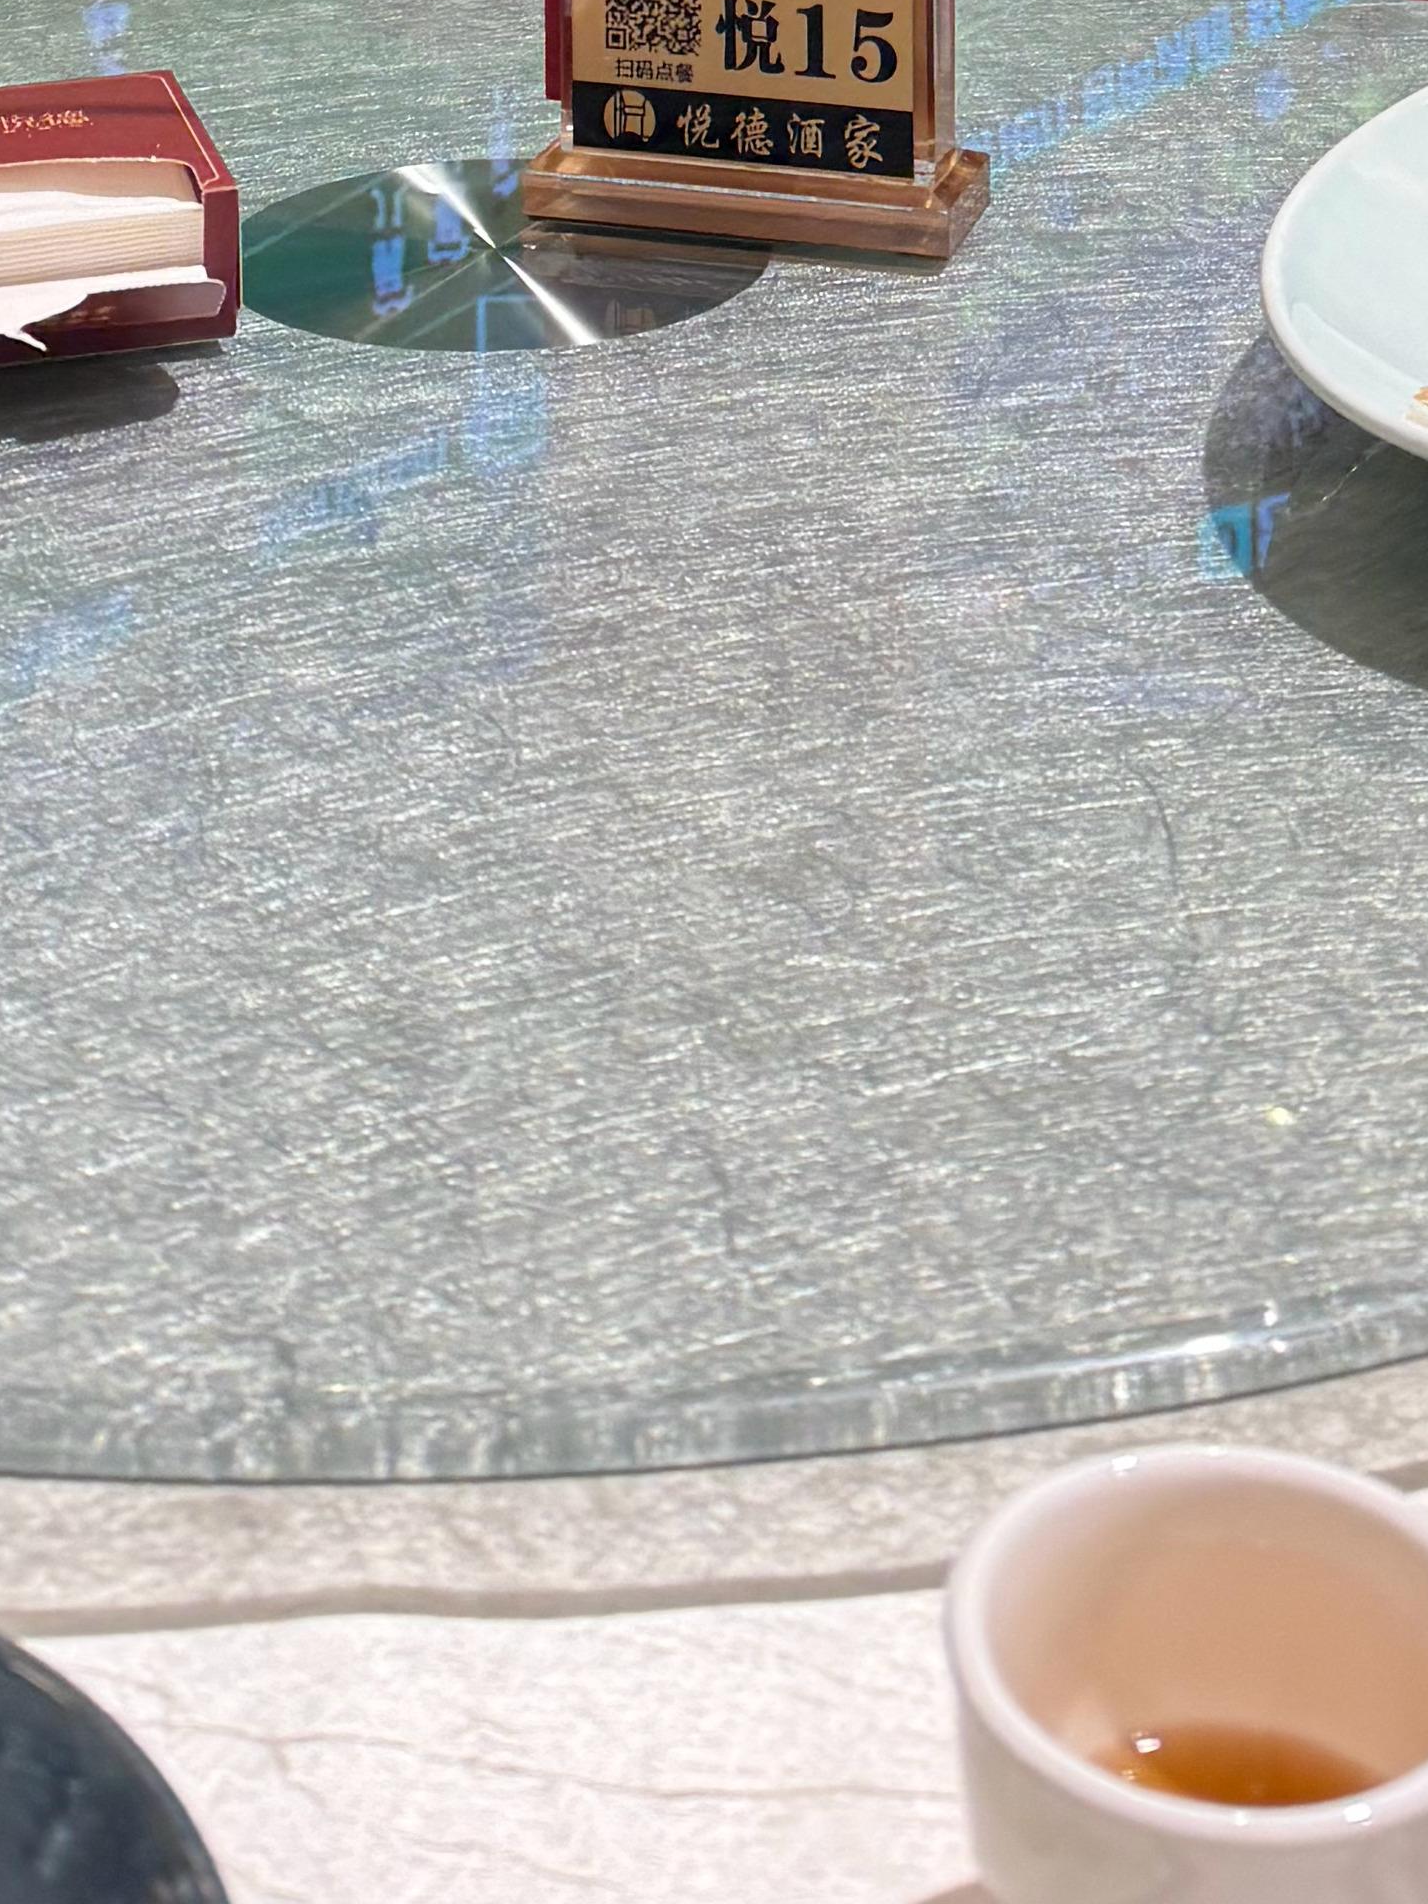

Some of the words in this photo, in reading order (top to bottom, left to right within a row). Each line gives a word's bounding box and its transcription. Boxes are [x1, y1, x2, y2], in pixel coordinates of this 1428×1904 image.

[615, 58, 694, 84] 扫码点餐
[675, 103, 884, 169] 悦德酒家
